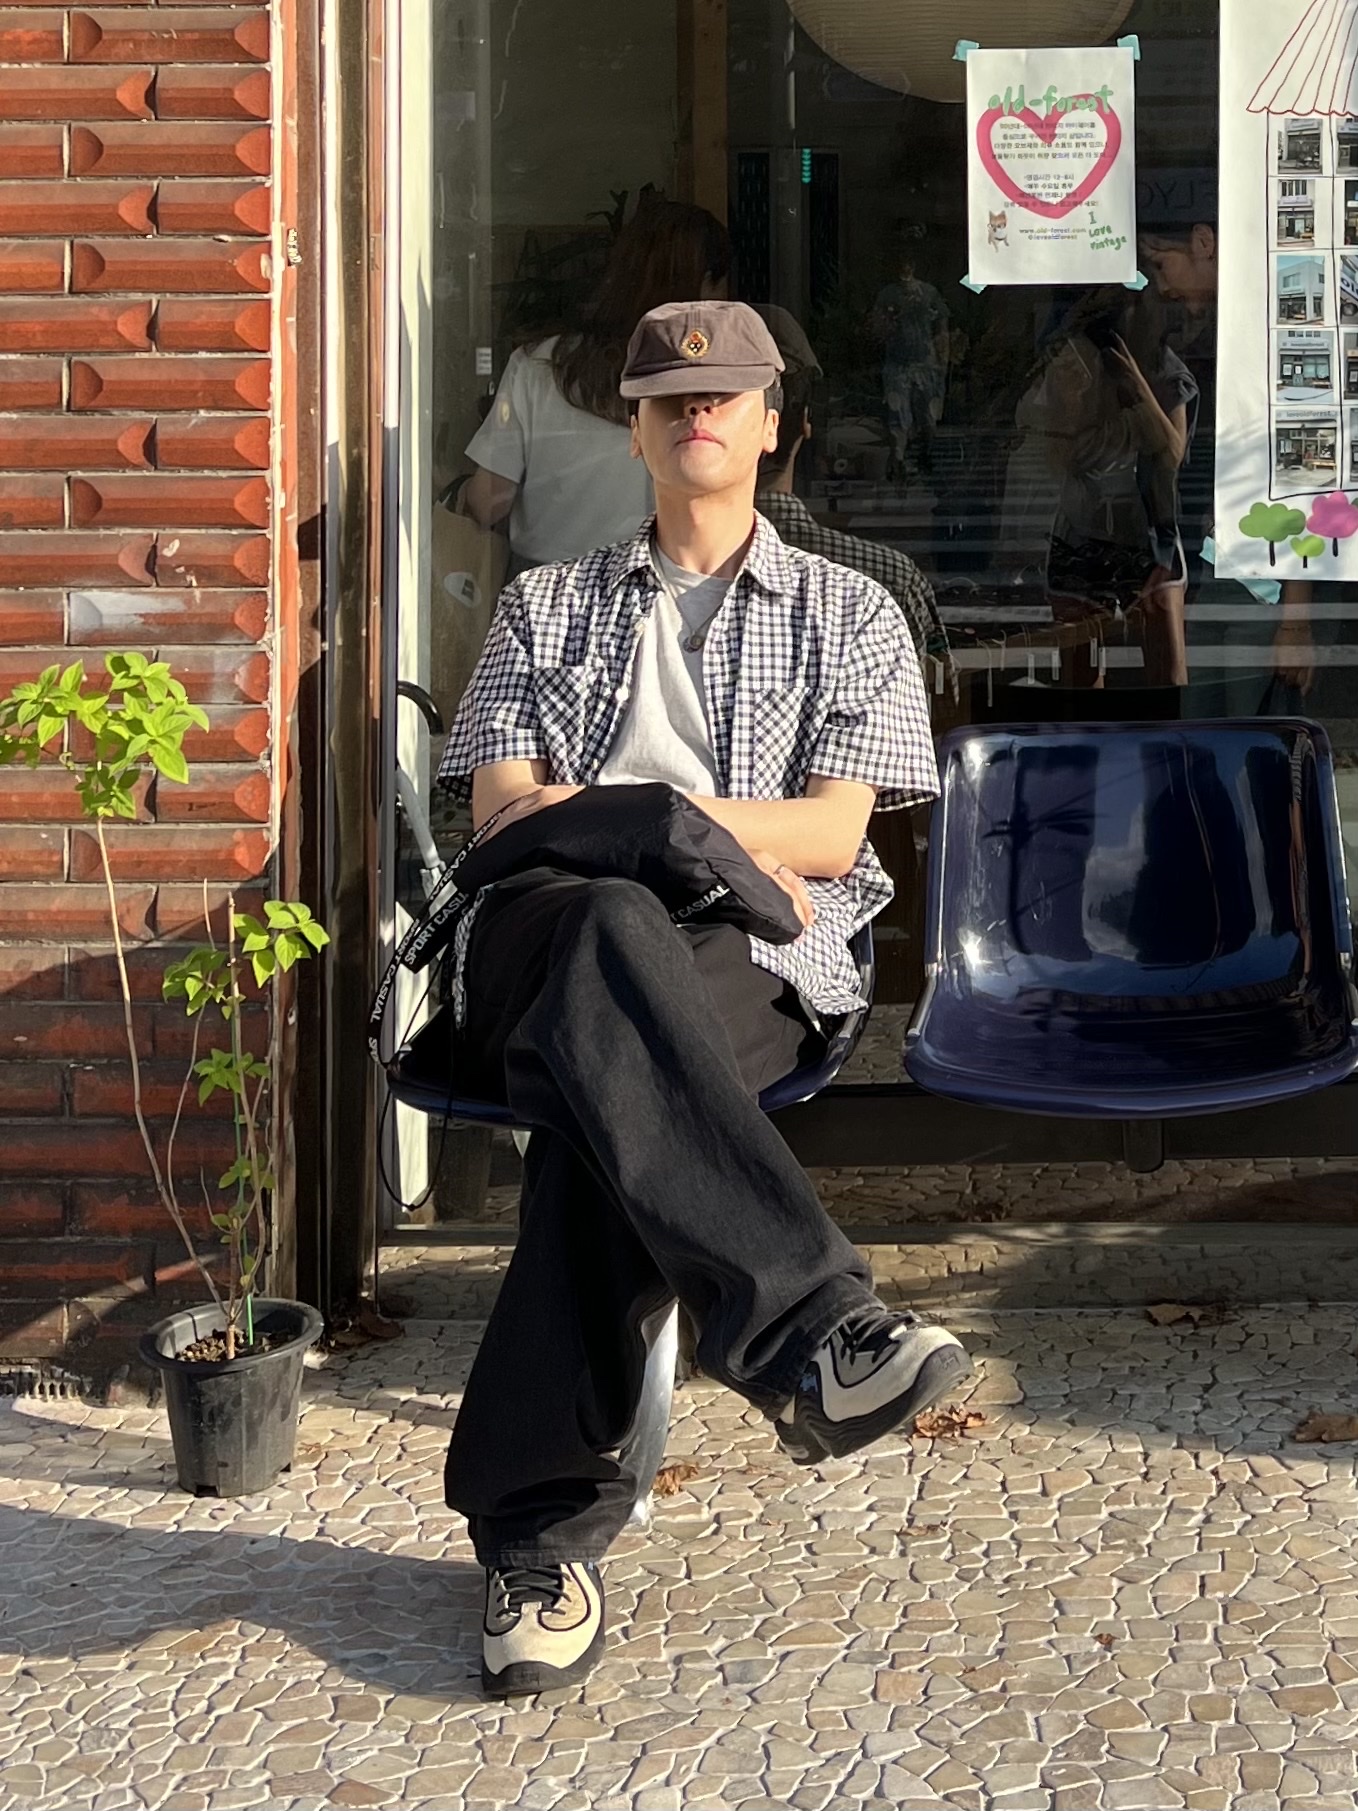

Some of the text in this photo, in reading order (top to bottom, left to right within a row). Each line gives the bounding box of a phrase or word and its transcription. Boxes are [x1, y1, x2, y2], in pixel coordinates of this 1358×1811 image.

[988, 84, 1114, 116] old-forest
[1088, 211, 1097, 225] I
[677, 884, 730, 918] CASUAL
[404, 892, 469, 965] SPORT CASU
[370, 963, 396, 1023] CASUAL
